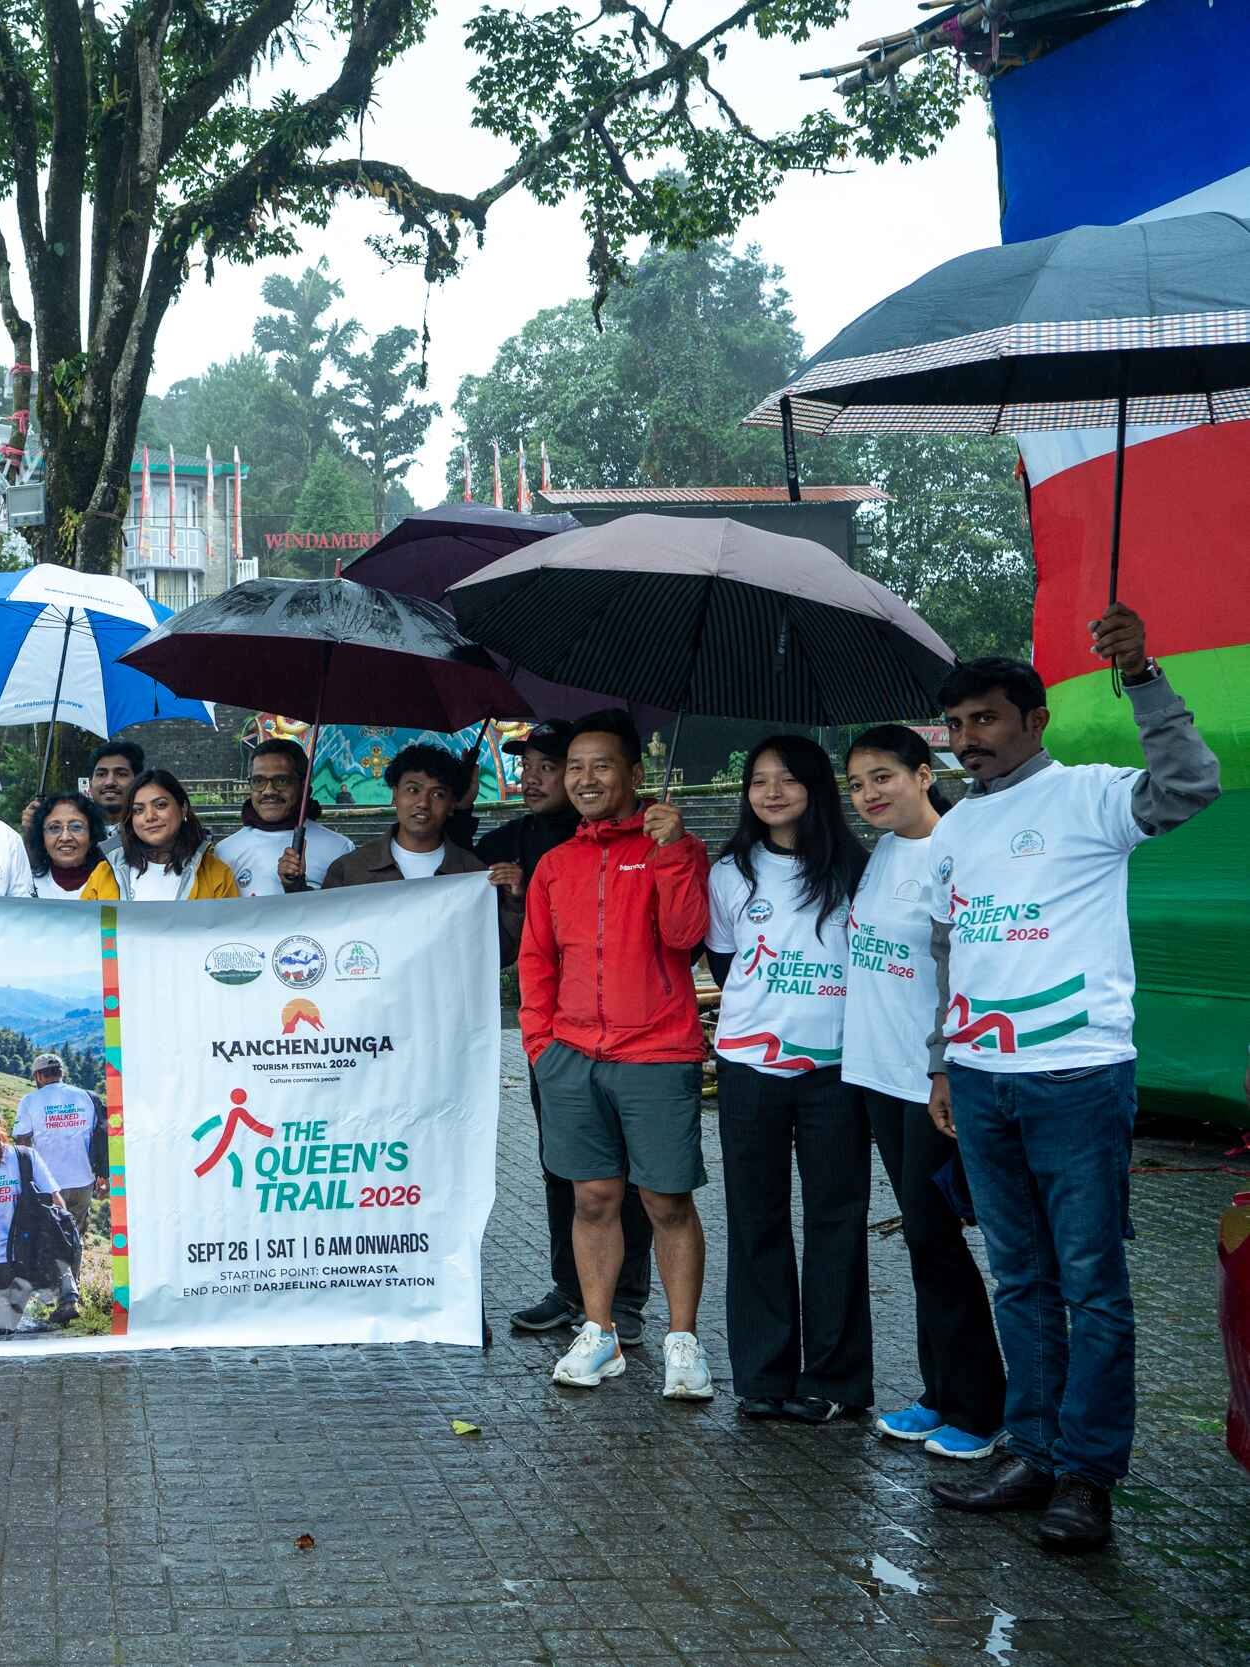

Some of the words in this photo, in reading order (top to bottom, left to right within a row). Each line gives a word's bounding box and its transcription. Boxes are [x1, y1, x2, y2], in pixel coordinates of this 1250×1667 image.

[971, 895, 995, 909] THE
[957, 903, 1041, 930] QUEEN'S
[860, 923, 876, 936] THE
[1006, 928, 1049, 941] 2026
[781, 951, 804, 960] THE
[852, 934, 910, 960] QUEEN'S
[767, 962, 843, 980] QUEEN'S
[852, 952, 885, 972] TRAIL
[887, 964, 915, 978] 2026
[767, 979, 815, 995] TRAIL
[818, 985, 847, 996] 2026
[212, 1036, 394, 1062] KANCHENJUNGA
[252, 1063, 288, 1071] TOURISM
[291, 1062, 327, 1070] FESTIVAL
[329, 1059, 356, 1068] 2026
[282, 1120, 328, 1142] THE
[255, 1141, 409, 1181] QUEEN'S
[256, 1179, 355, 1213] TRAIL
[359, 1185, 421, 1208] 2026
[187, 1241, 224, 1263] SEPT
[228, 1240, 248, 1261] 26
[267, 1238, 296, 1259] SAT
[315, 1236, 324, 1256] 6
[328, 1236, 352, 1256] AM
[355, 1232, 429, 1255] ONWARDS
[220, 1268, 277, 1281] STARTING
[280, 1267, 319, 1278] POINT:
[322, 1264, 399, 1276] CHOWRASTA
[183, 1287, 208, 1297] END
[212, 1284, 251, 1295] POINT:
[253, 1280, 327, 1293] DARJEELING
[330, 1277, 382, 1289] RAILWAY
[385, 1277, 435, 1287] STATION
